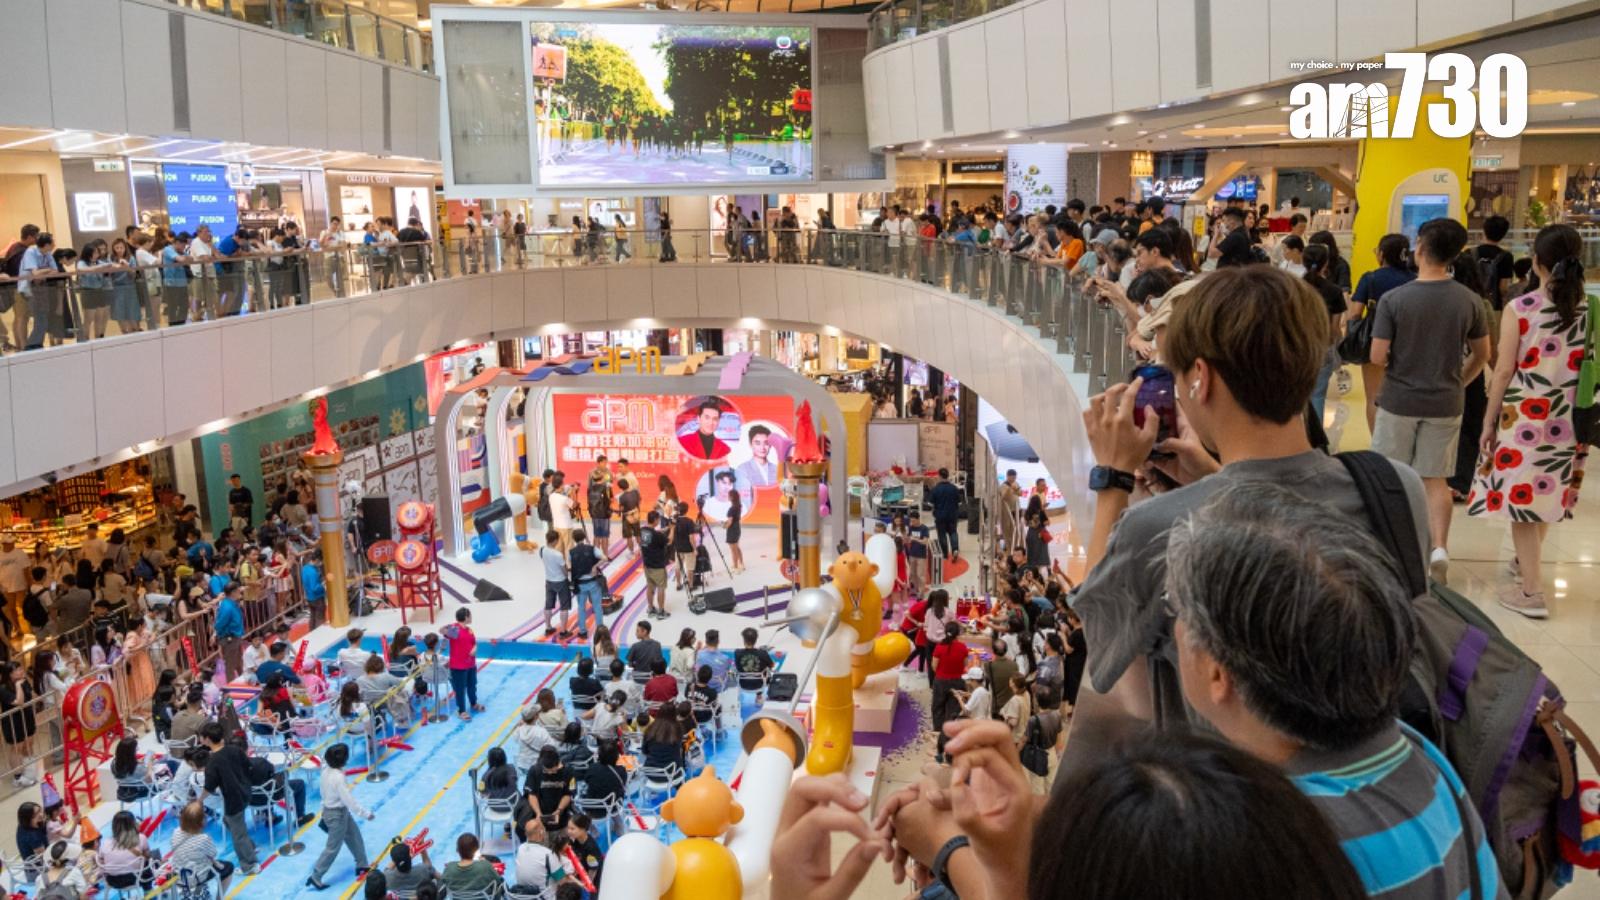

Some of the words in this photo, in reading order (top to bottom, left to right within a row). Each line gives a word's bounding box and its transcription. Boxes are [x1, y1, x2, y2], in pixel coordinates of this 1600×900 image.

[190, 173, 217, 182] FUSION
[191, 195, 218, 203] FUSION
[199, 216, 225, 224] FUSION
